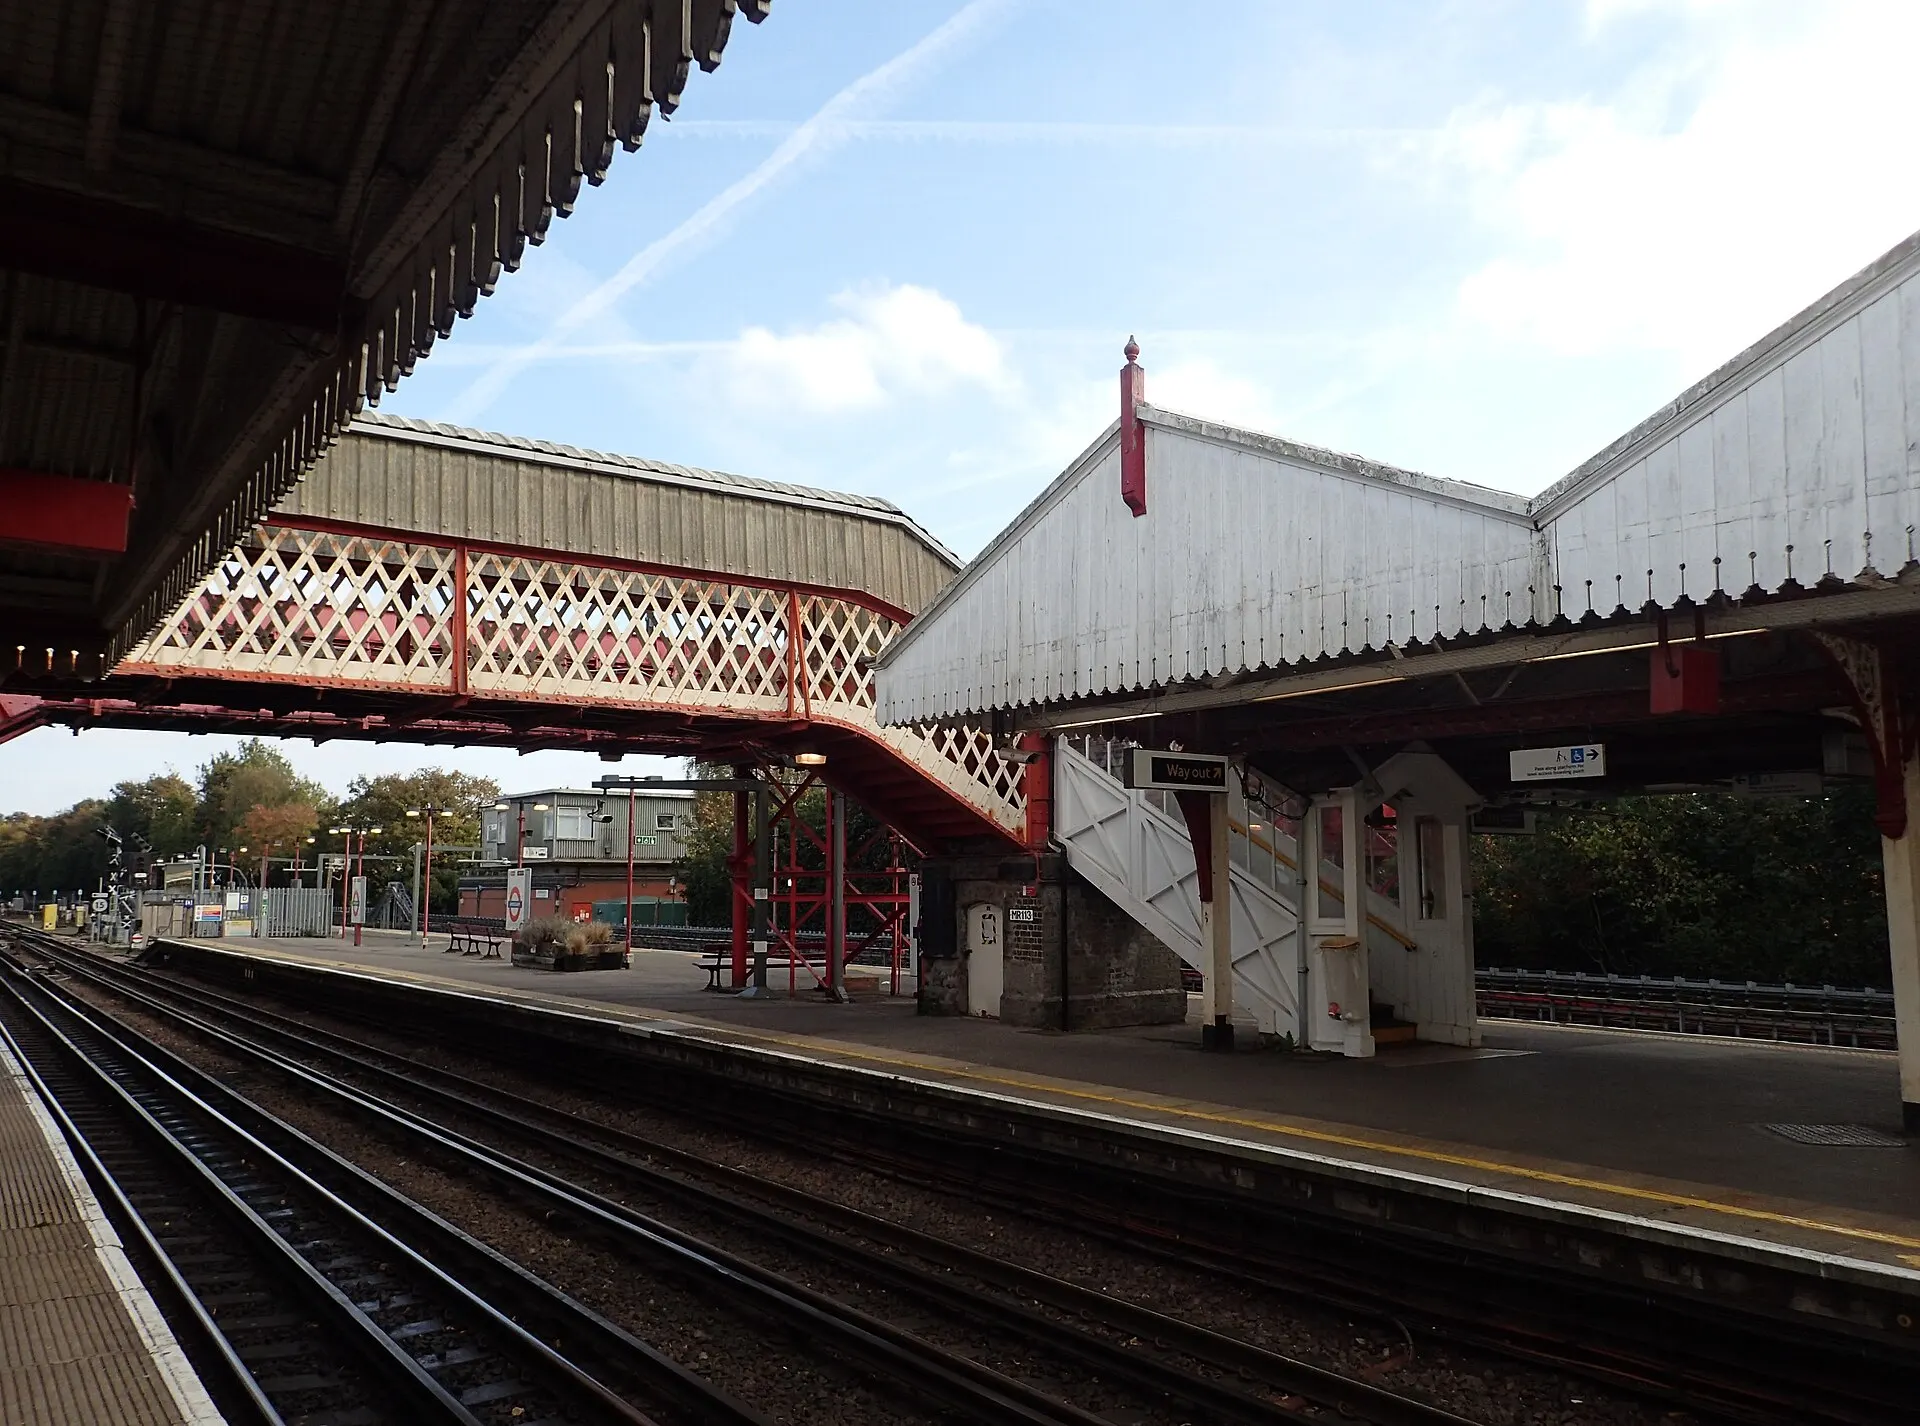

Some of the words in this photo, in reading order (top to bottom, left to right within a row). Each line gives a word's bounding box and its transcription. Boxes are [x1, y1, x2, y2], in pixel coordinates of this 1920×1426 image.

[1166, 763, 1190, 780] Way
[1192, 767, 1211, 778] out
[1011, 910, 1032, 920] MR113
